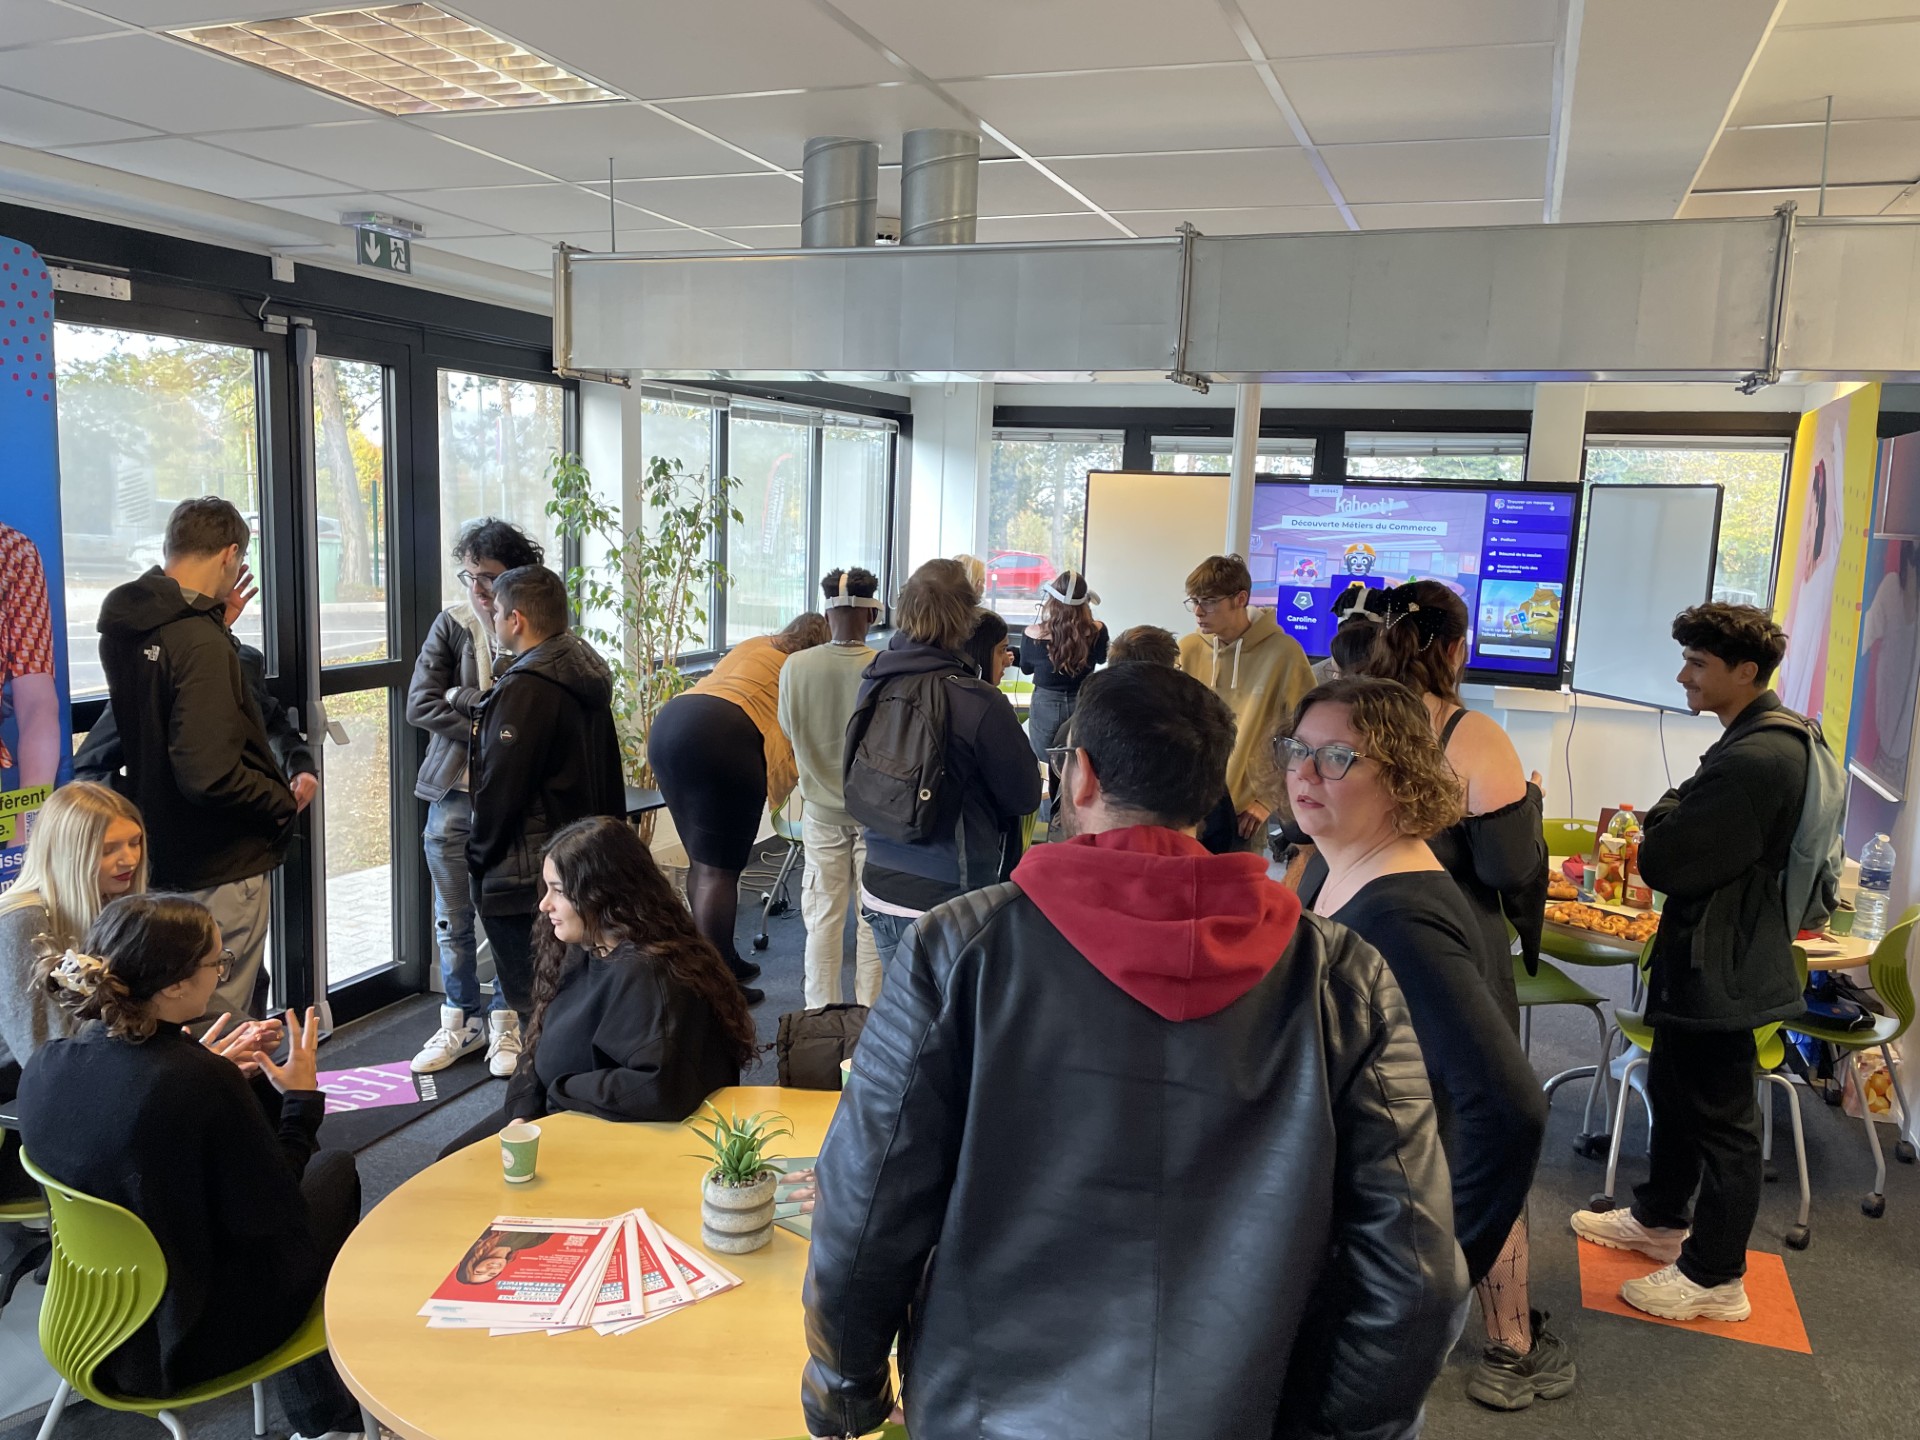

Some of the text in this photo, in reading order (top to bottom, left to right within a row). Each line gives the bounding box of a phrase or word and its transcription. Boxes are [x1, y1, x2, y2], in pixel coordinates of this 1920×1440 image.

[1335, 495, 1395, 516] Kahoot!
[1291, 519, 1437, 532] Découverte Métiers du Commerce
[1300, 596, 1307, 605] 2
[1286, 615, 1317, 624] Caroline
[0, 852, 26, 869] iss
